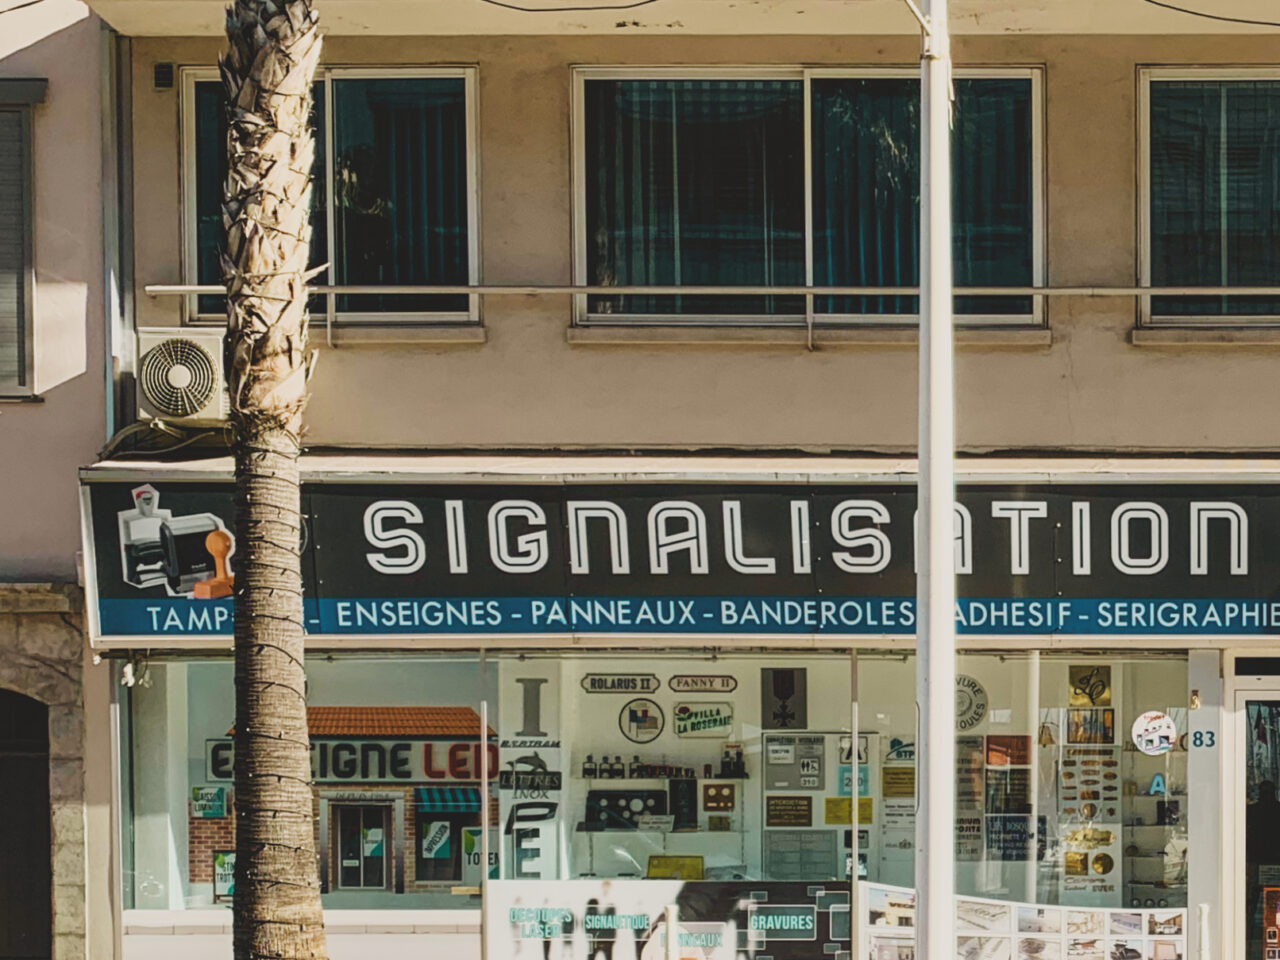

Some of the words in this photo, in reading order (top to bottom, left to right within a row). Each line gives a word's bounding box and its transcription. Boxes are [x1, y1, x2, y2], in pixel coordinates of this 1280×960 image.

[147, 606, 236, 631] TAMP
[337, 601, 501, 627] ENSEIGNES
[531, 600, 696, 627] PANNEAUX
[721, 601, 915, 627] BANDEROLES
[676, 678, 715, 688] FANNY
[690, 708, 721, 720] VILLA
[677, 723, 688, 734] LA
[1192, 730, 1216, 748] 83
[211, 743, 412, 780] EIGNE
[423, 743, 500, 780] LED
[502, 774, 559, 787] LETTRES
[1150, 773, 1166, 795] A
[512, 789, 549, 799] INOX
[509, 907, 573, 923] DECOUPES
[585, 914, 650, 930] SIGNALETIQUE
[750, 915, 814, 930] GRAVURES
[521, 924, 562, 938] LASER
